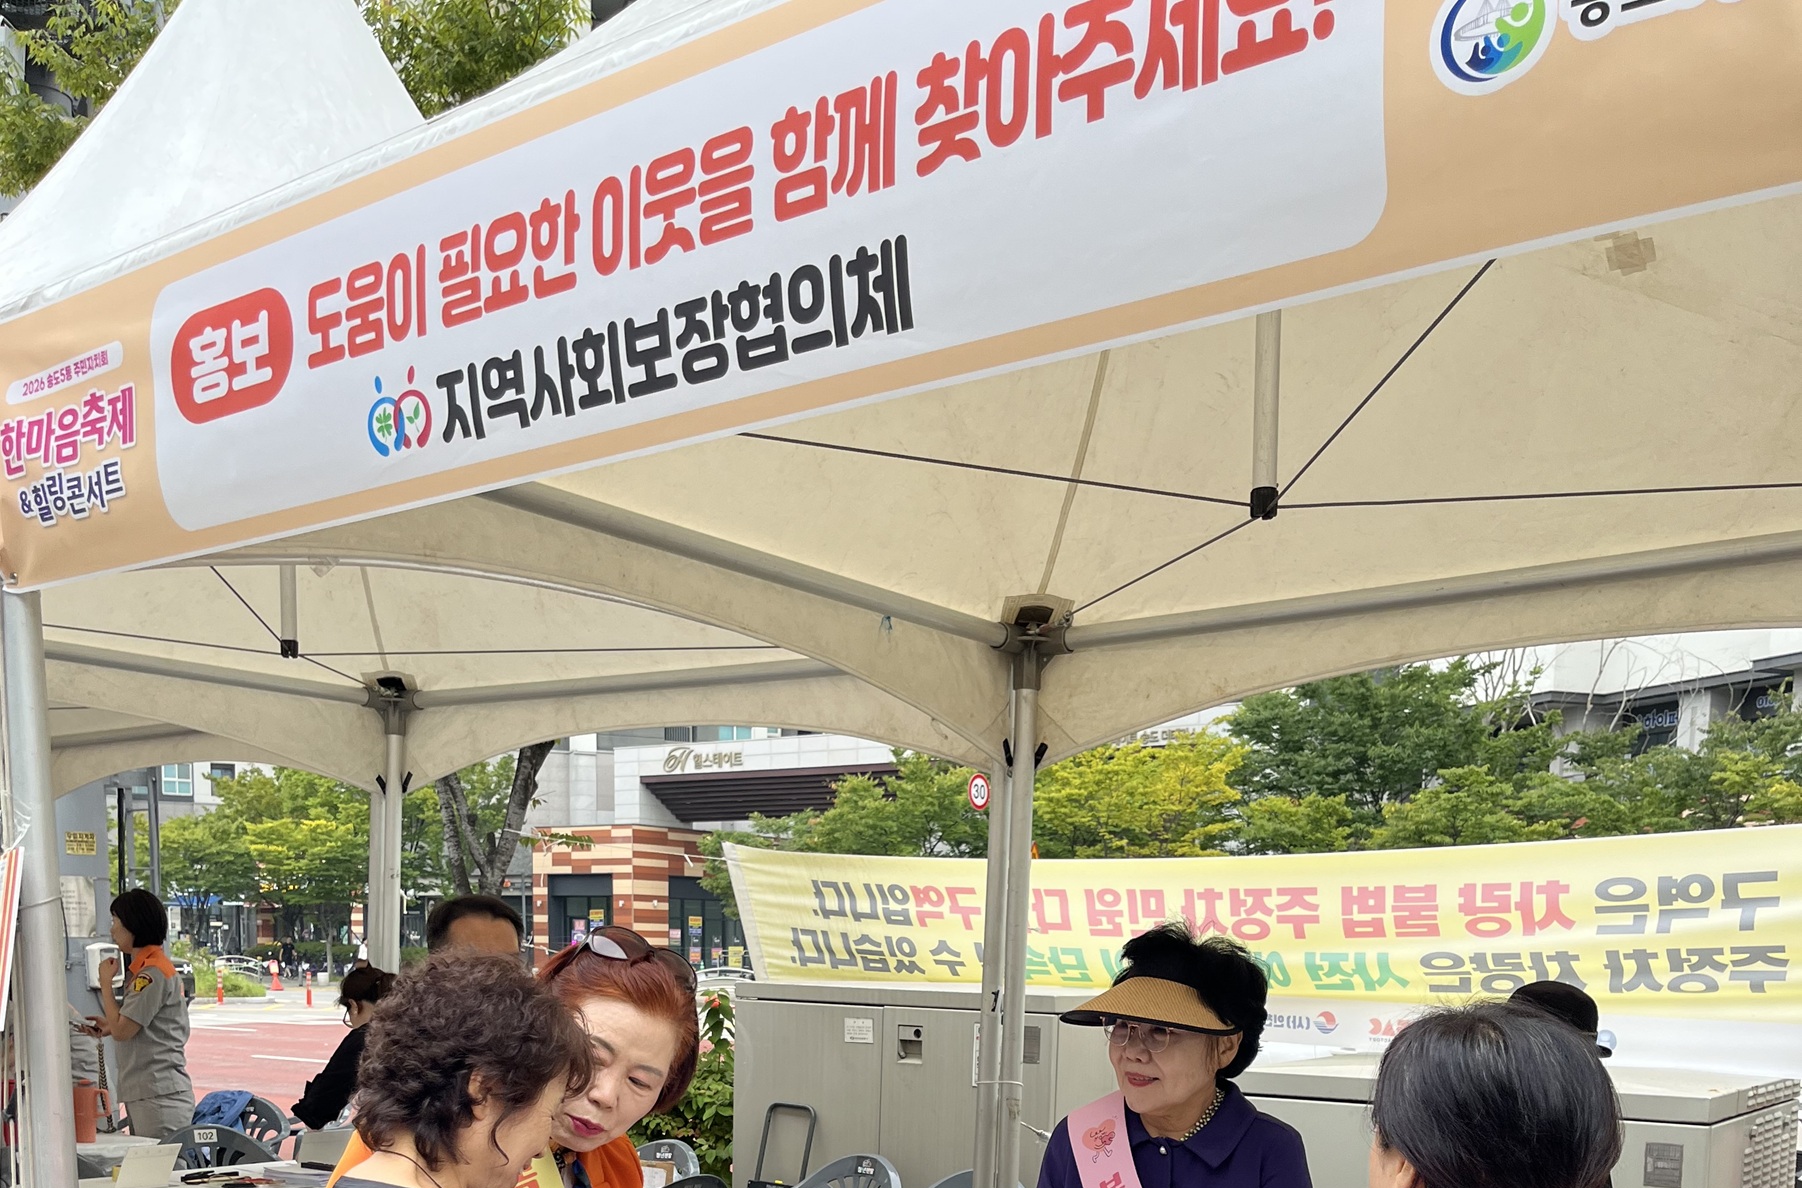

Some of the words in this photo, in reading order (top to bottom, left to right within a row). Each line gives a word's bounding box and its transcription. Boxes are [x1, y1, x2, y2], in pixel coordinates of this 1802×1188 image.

[190, 309, 273, 404] 홍보
[307, 244, 427, 370] 도움이
[439, 198, 580, 329] 필요한
[592, 125, 754, 276] 이웃을
[771, 70, 898, 223] 함께
[436, 234, 914, 445] 지역사회보장협의체
[22, 378, 45, 397] 2026
[0, 386, 134, 476] 한마음축제
[973, 784, 985, 799] 30
[197, 1132, 214, 1141] 102
